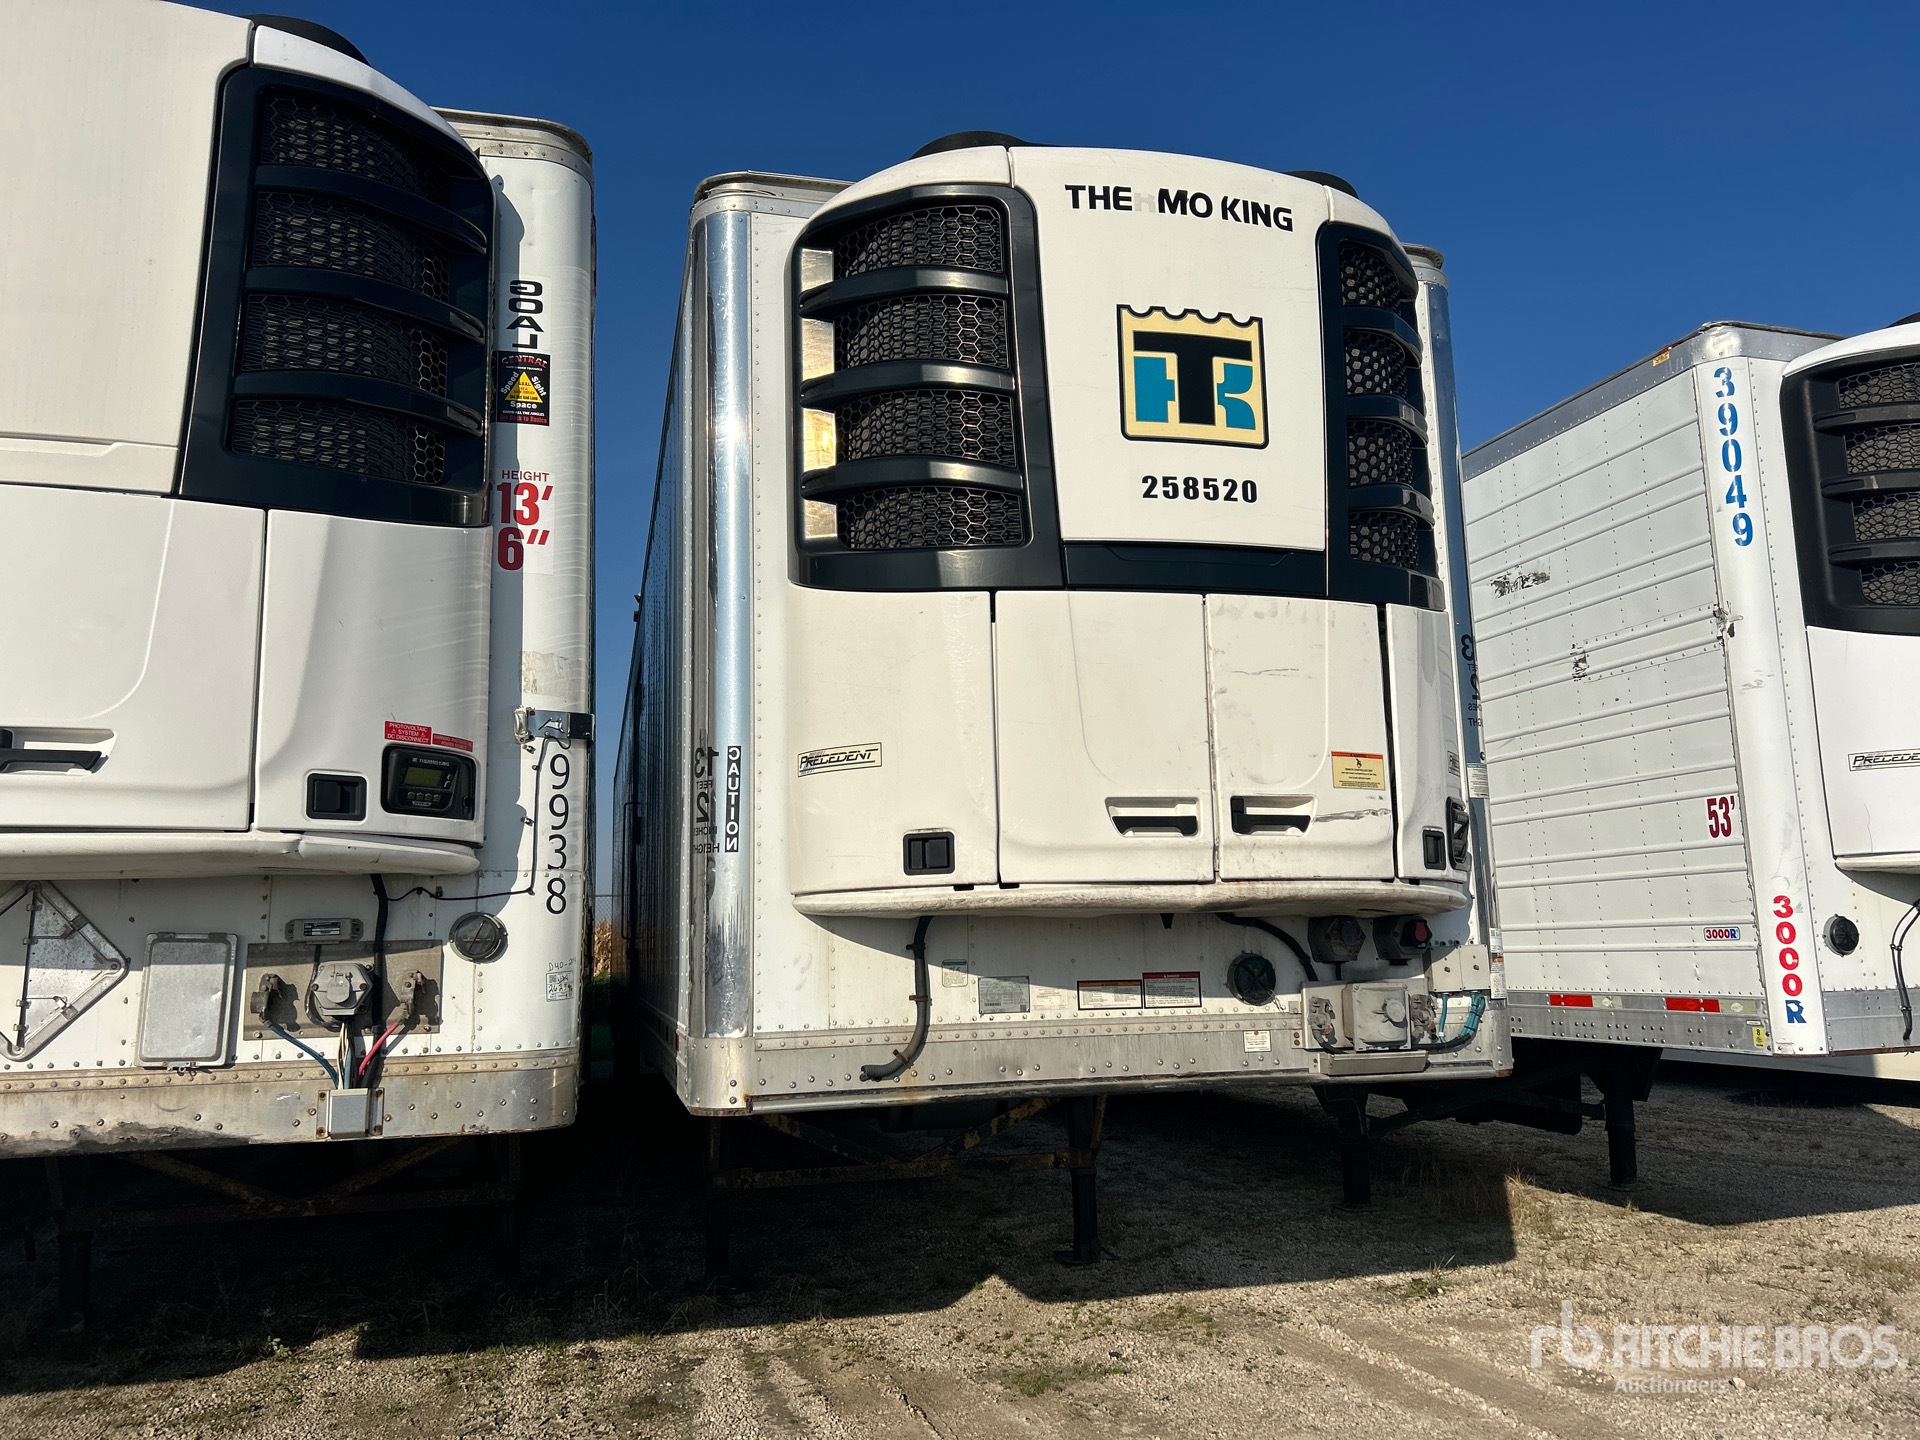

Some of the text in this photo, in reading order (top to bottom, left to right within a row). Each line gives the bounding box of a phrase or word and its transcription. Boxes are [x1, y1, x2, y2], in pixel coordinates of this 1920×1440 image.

[1220, 195, 1294, 232] KING
[501, 354, 548, 368] CENTRAL
[501, 371, 519, 394] Speed
[531, 376, 547, 396] Sight
[510, 400, 538, 409] Space
[1713, 366, 1754, 547] 39049
[501, 469, 550, 482] HEIGHT
[1141, 474, 1257, 504] 258520
[389, 722, 428, 733] PHOTOVOLTAIC
[396, 734, 429, 743] DISCONNECT
[799, 748, 879, 769] PRECEDENT
[1706, 795, 1736, 839] 53'
[545, 753, 570, 915] 9938
[1772, 895, 1807, 1024] 3000R
